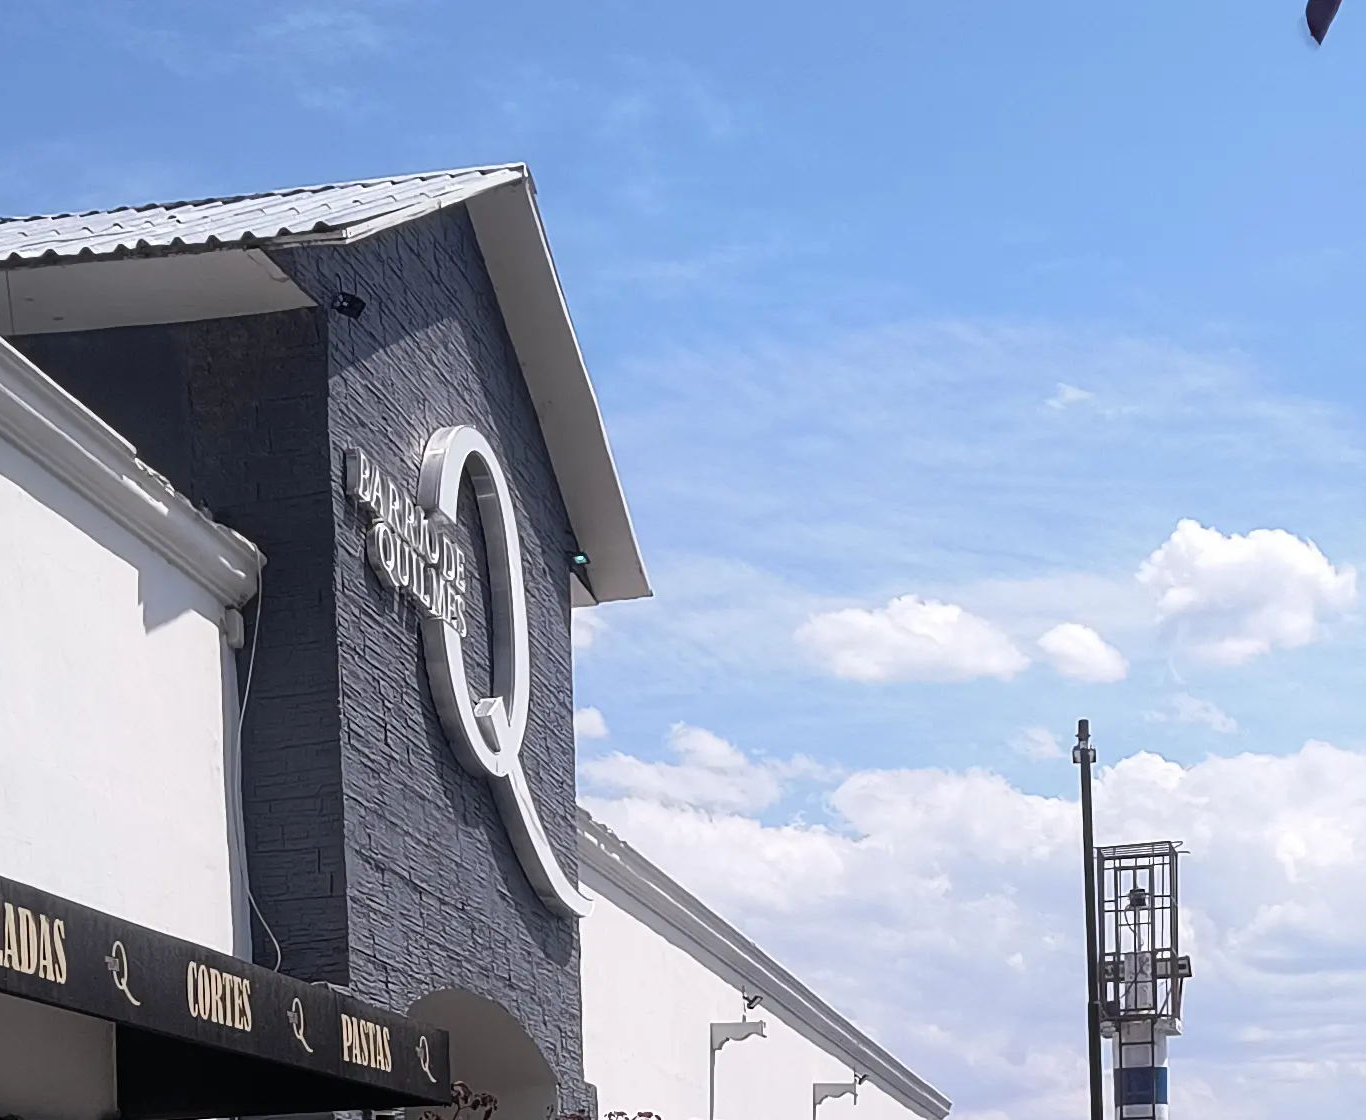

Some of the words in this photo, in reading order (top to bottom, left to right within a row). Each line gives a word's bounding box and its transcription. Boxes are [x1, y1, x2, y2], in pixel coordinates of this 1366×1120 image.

[355, 450, 440, 564] BARRIO
[442, 533, 466, 594] DE
[371, 522, 467, 638] QUILMES
[417, 425, 595, 917] Q
[186, 960, 252, 1033] CORTES
[340, 1013, 392, 1073] PASTAS
